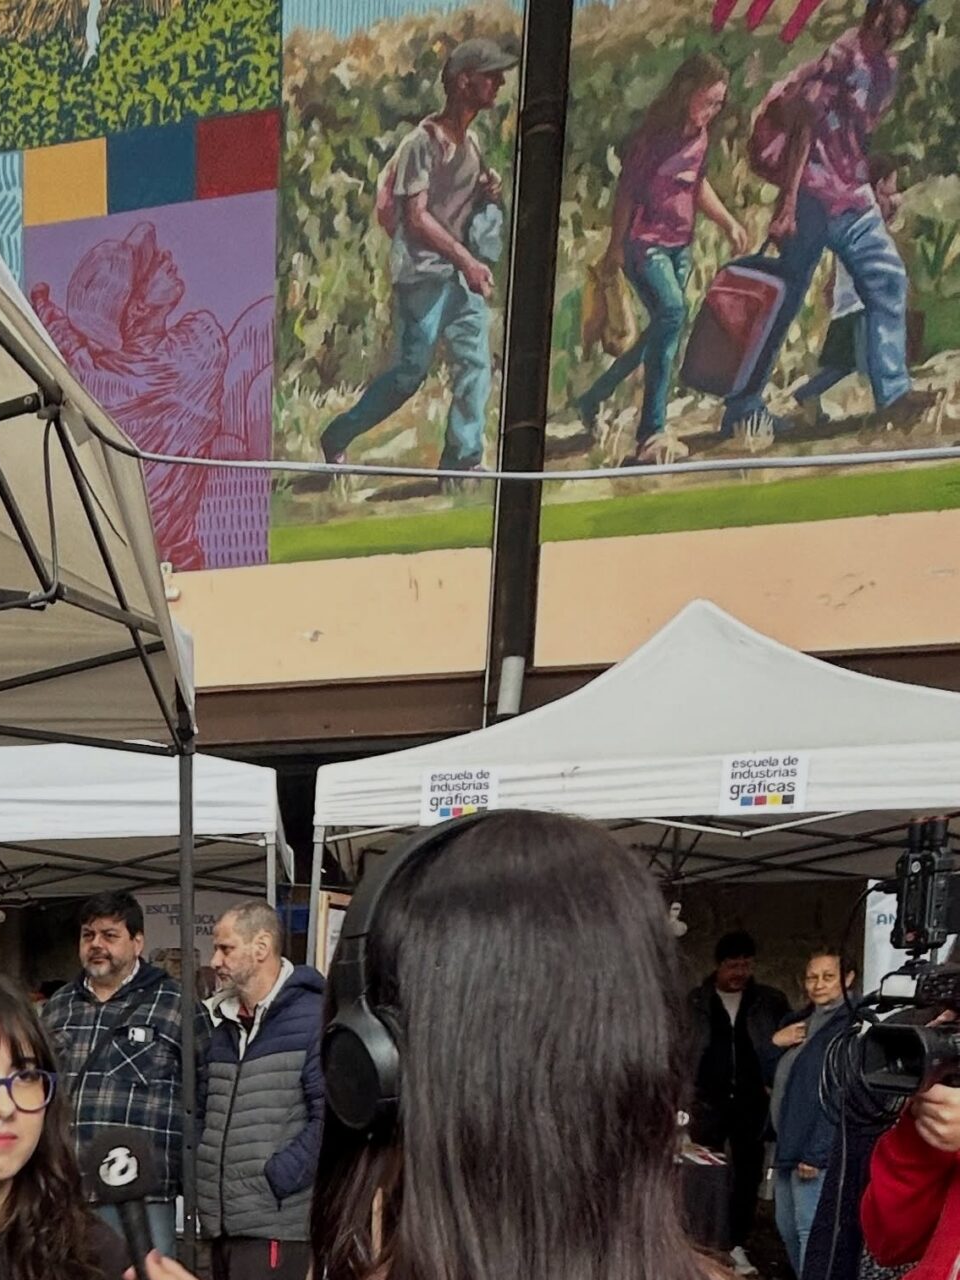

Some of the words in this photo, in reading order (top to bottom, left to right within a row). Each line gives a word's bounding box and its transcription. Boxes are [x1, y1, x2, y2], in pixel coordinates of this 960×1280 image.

[731, 756, 779, 768] escuela
[782, 755, 799, 766] de
[430, 770, 473, 781] escuela
[476, 769, 490, 780] de
[730, 768, 798, 779] industrias
[430, 781, 490, 793] industrias
[729, 780, 796, 801] gráficas
